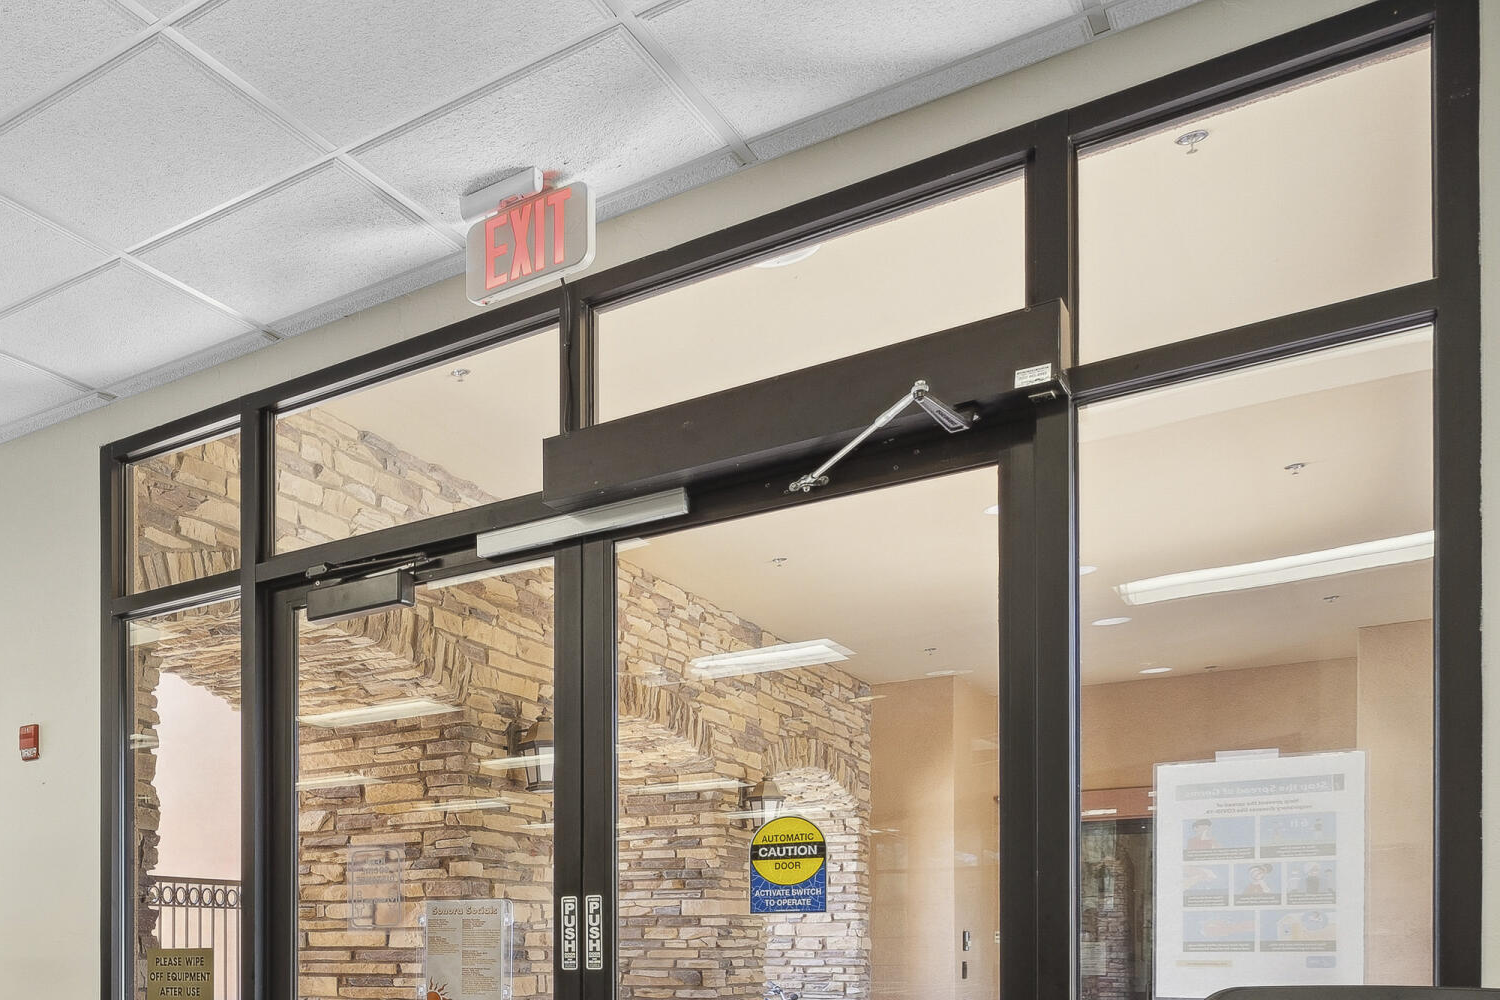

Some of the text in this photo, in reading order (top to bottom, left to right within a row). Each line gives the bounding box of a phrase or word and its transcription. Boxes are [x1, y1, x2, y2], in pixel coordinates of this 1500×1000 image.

[484, 187, 572, 291] EXIT
[761, 832, 814, 843] AUTOMATIC
[758, 845, 818, 857] CAUTION
[774, 861, 801, 870] DOOR
[754, 887, 822, 897] ACTIVATE SWITCH
[764, 898, 812, 907] TO OPERATE
[432, 906, 498, 916] Sonora Socials
[564, 902, 576, 952] PUSH
[588, 901, 600, 952] PUSH
[155, 957, 205, 966] PLEASE WIPE
[150, 972, 211, 981] OFF EQUIPMENT
[160, 987, 200, 997] AFTER USE
